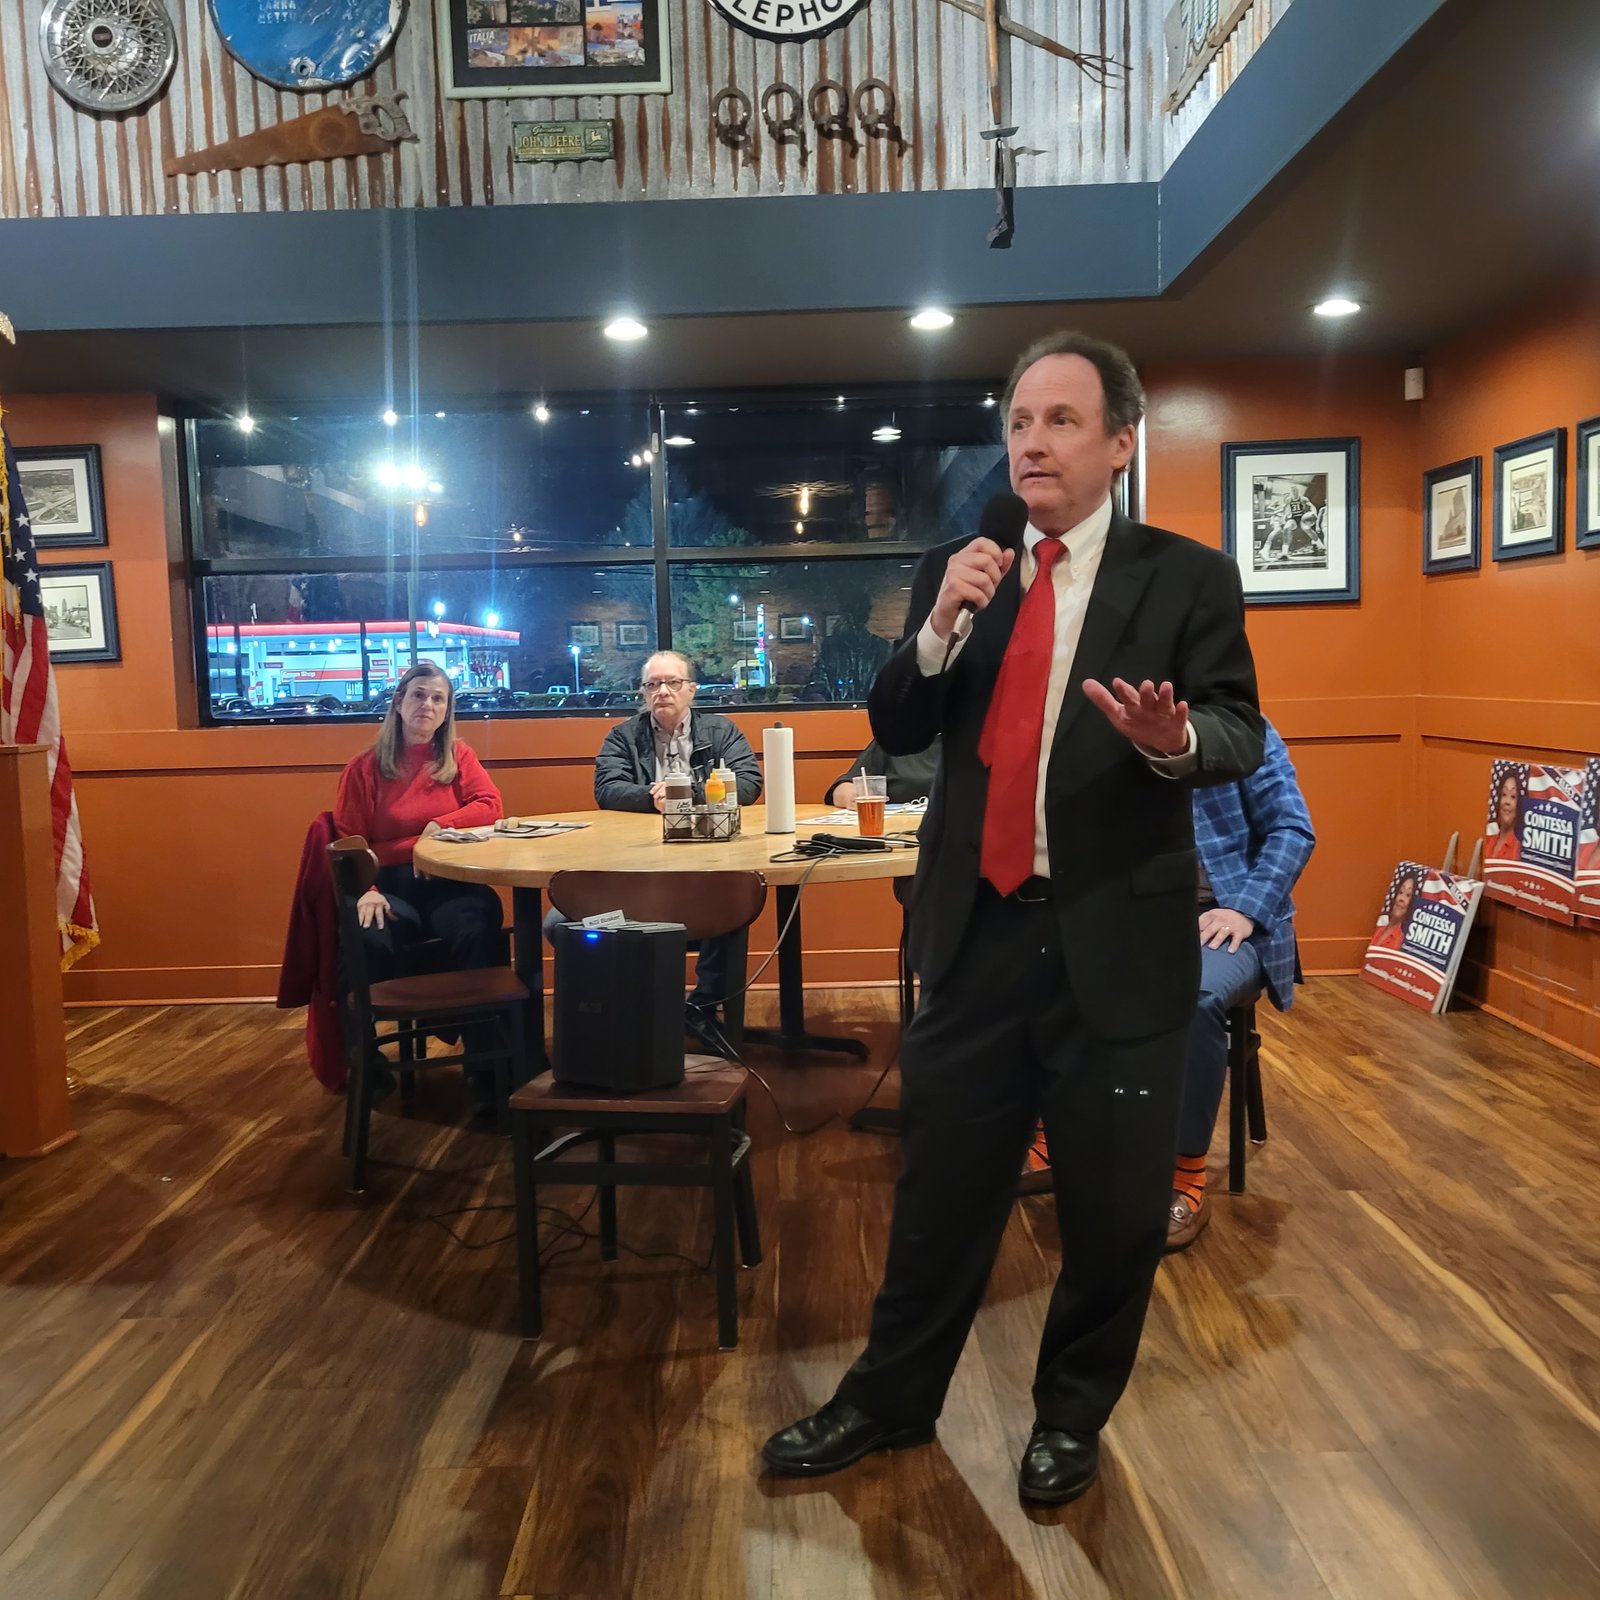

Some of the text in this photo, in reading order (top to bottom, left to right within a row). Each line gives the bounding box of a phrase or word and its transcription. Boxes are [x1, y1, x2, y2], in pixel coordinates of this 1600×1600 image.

[469, 30, 496, 43] ITALIA
[518, 134, 581, 149] JOHN DEERE
[1524, 810, 1574, 836] CONTESSA
[1522, 826, 1573, 859] SMITH
[1412, 908, 1457, 936] CONTESSA
[1405, 922, 1454, 955] SMITH
